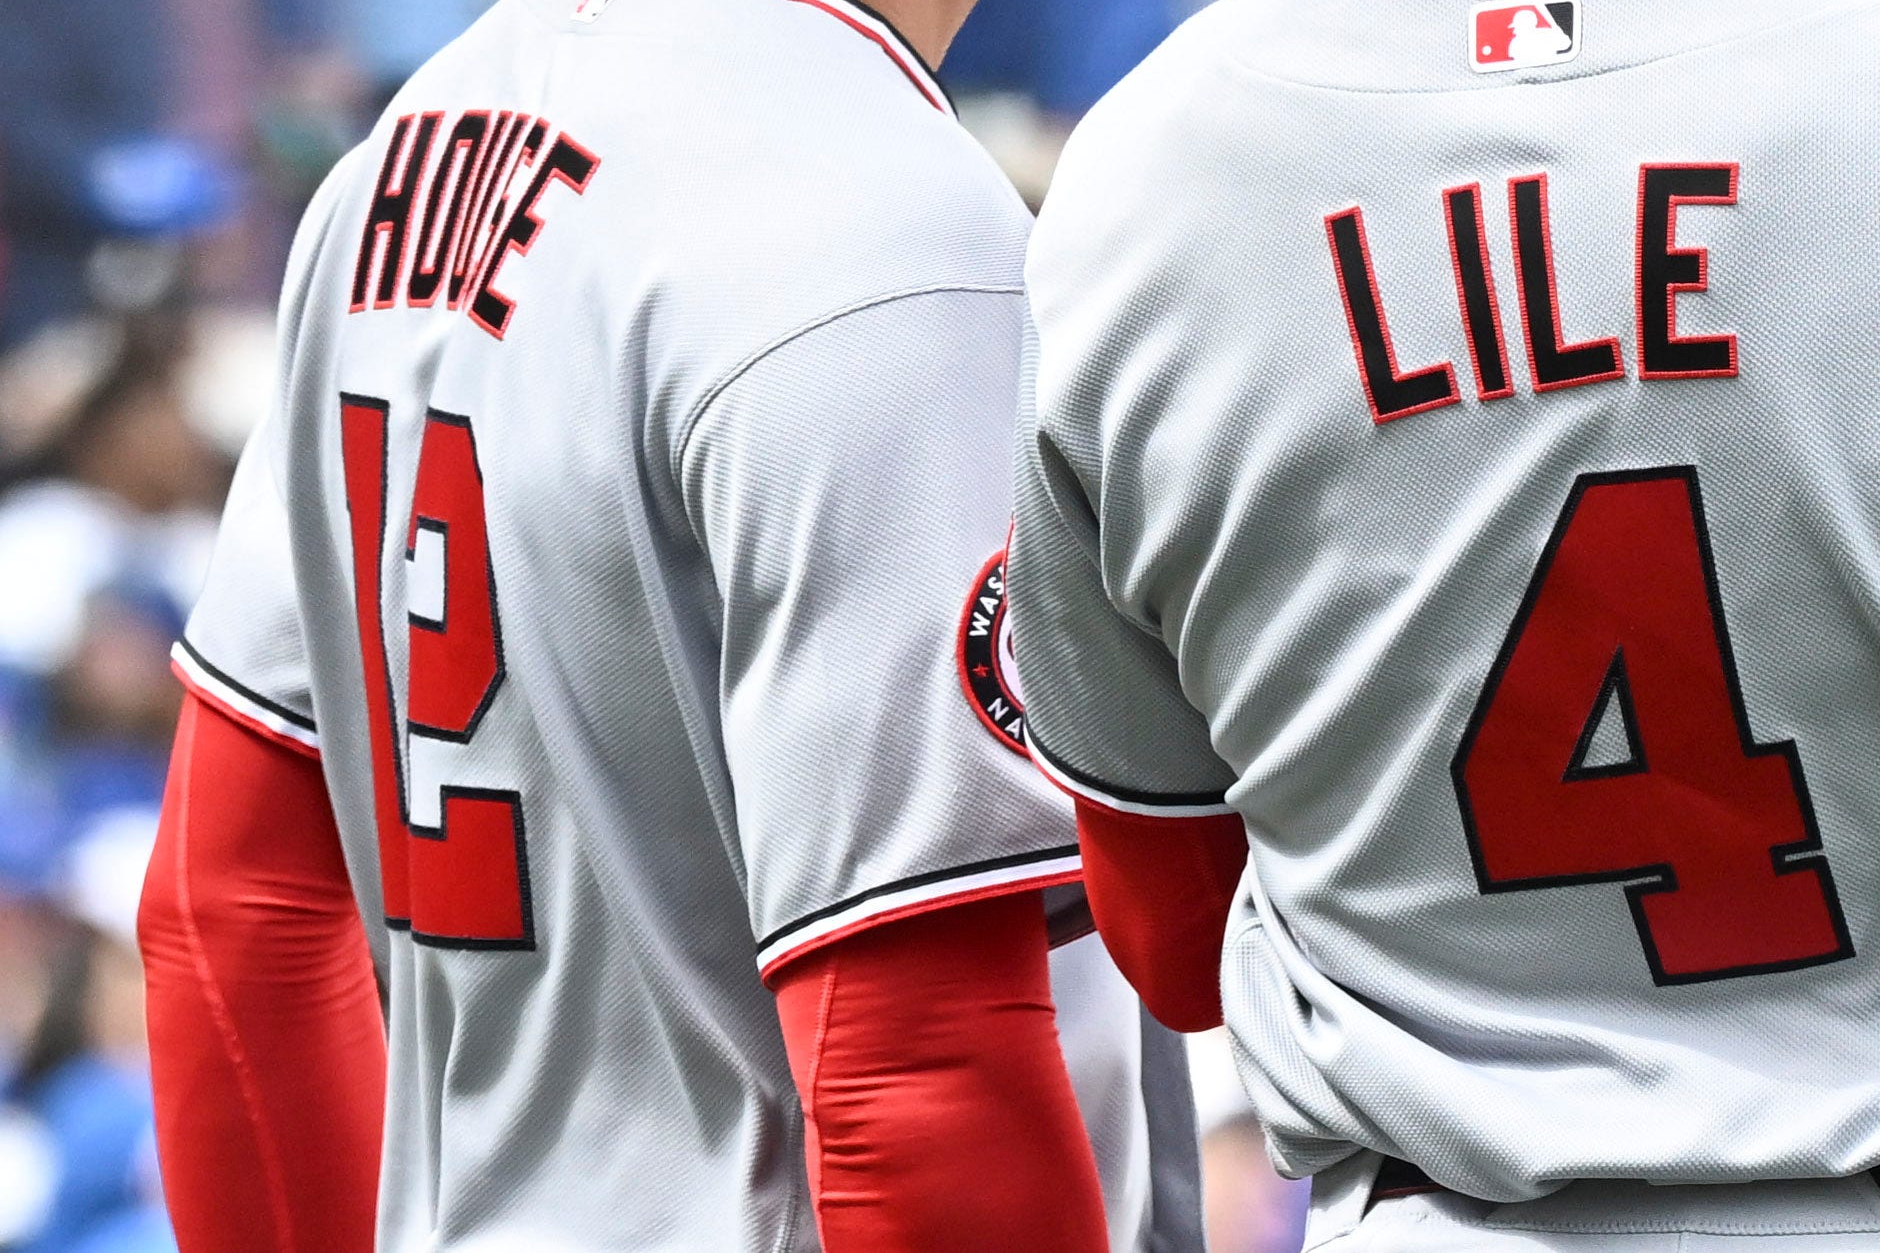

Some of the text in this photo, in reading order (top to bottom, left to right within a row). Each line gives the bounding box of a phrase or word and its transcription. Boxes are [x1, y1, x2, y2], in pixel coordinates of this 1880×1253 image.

[1323, 161, 1740, 426] LILE
[340, 391, 536, 952] 12
[1450, 464, 1857, 987] 4
